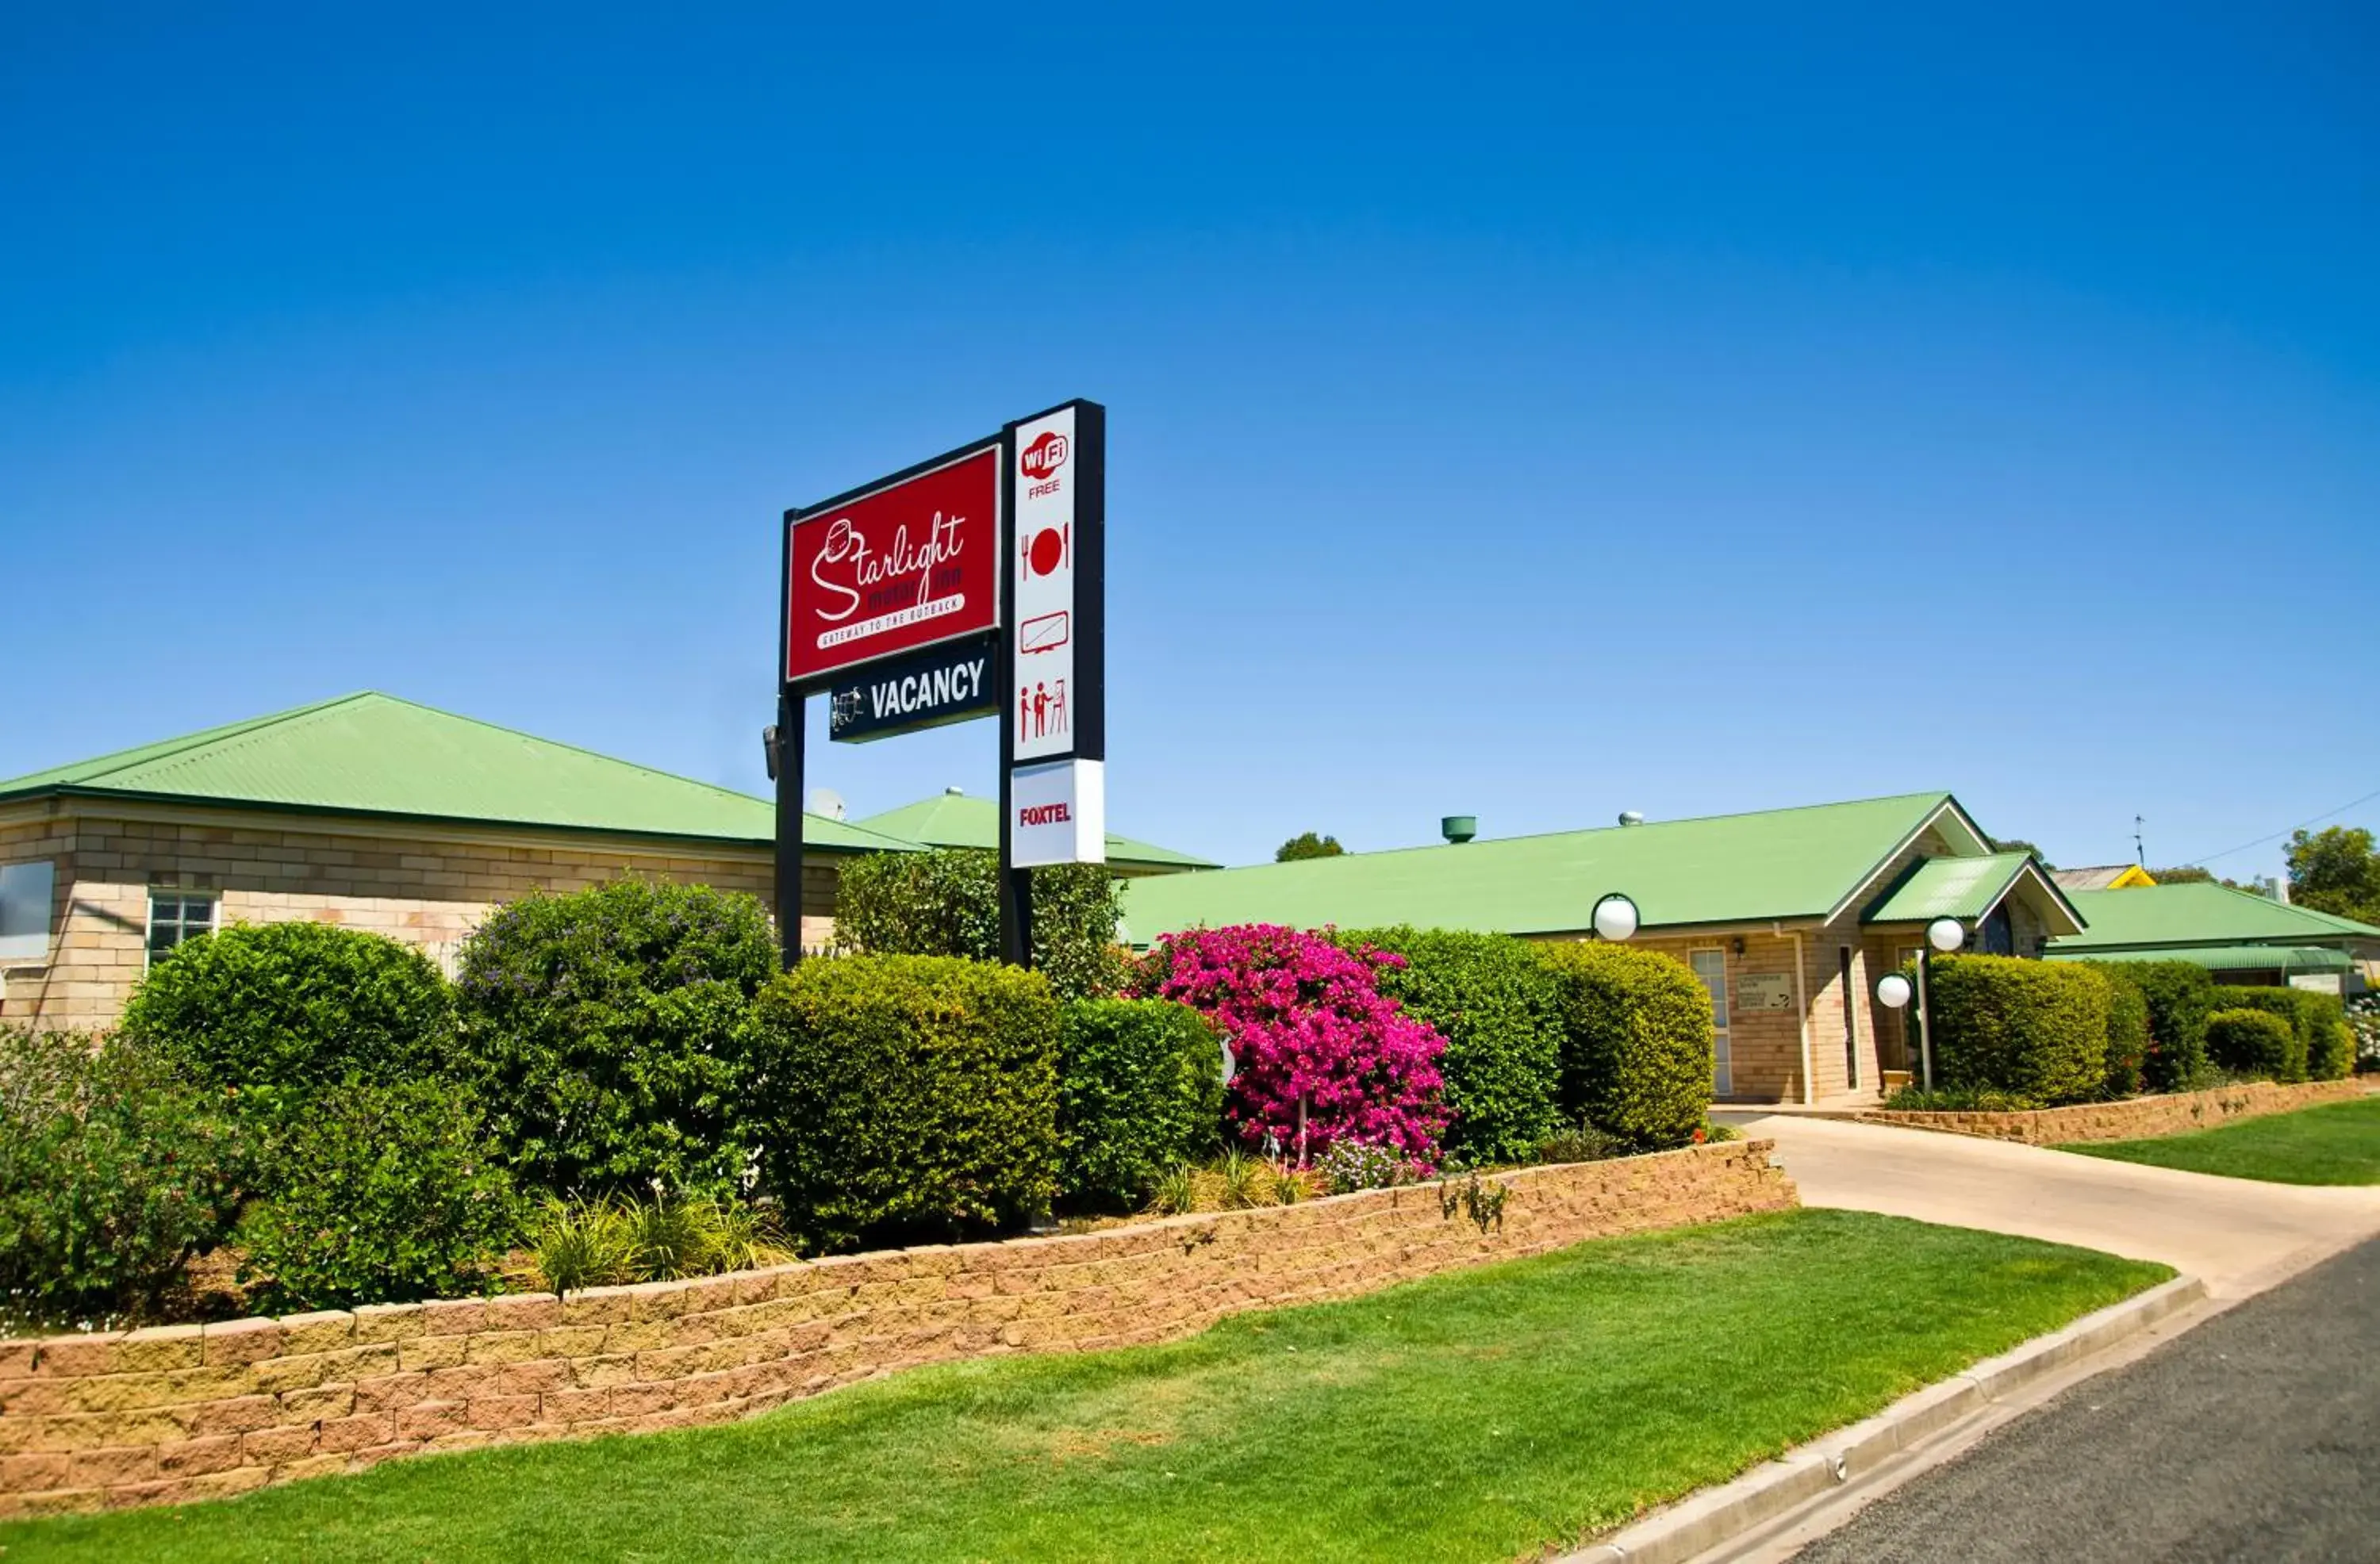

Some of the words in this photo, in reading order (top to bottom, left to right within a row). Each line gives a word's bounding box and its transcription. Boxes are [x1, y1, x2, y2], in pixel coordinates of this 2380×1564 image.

[1028, 479, 1061, 500] FREE
[812, 511, 966, 621] Starlight
[822, 625, 866, 646] GATEWAY
[869, 619, 881, 633] TO
[886, 612, 904, 628] THE
[910, 598, 958, 621] OUTBACK
[870, 657, 985, 720] VACANCY
[1020, 803, 1071, 827] FOXTEL
